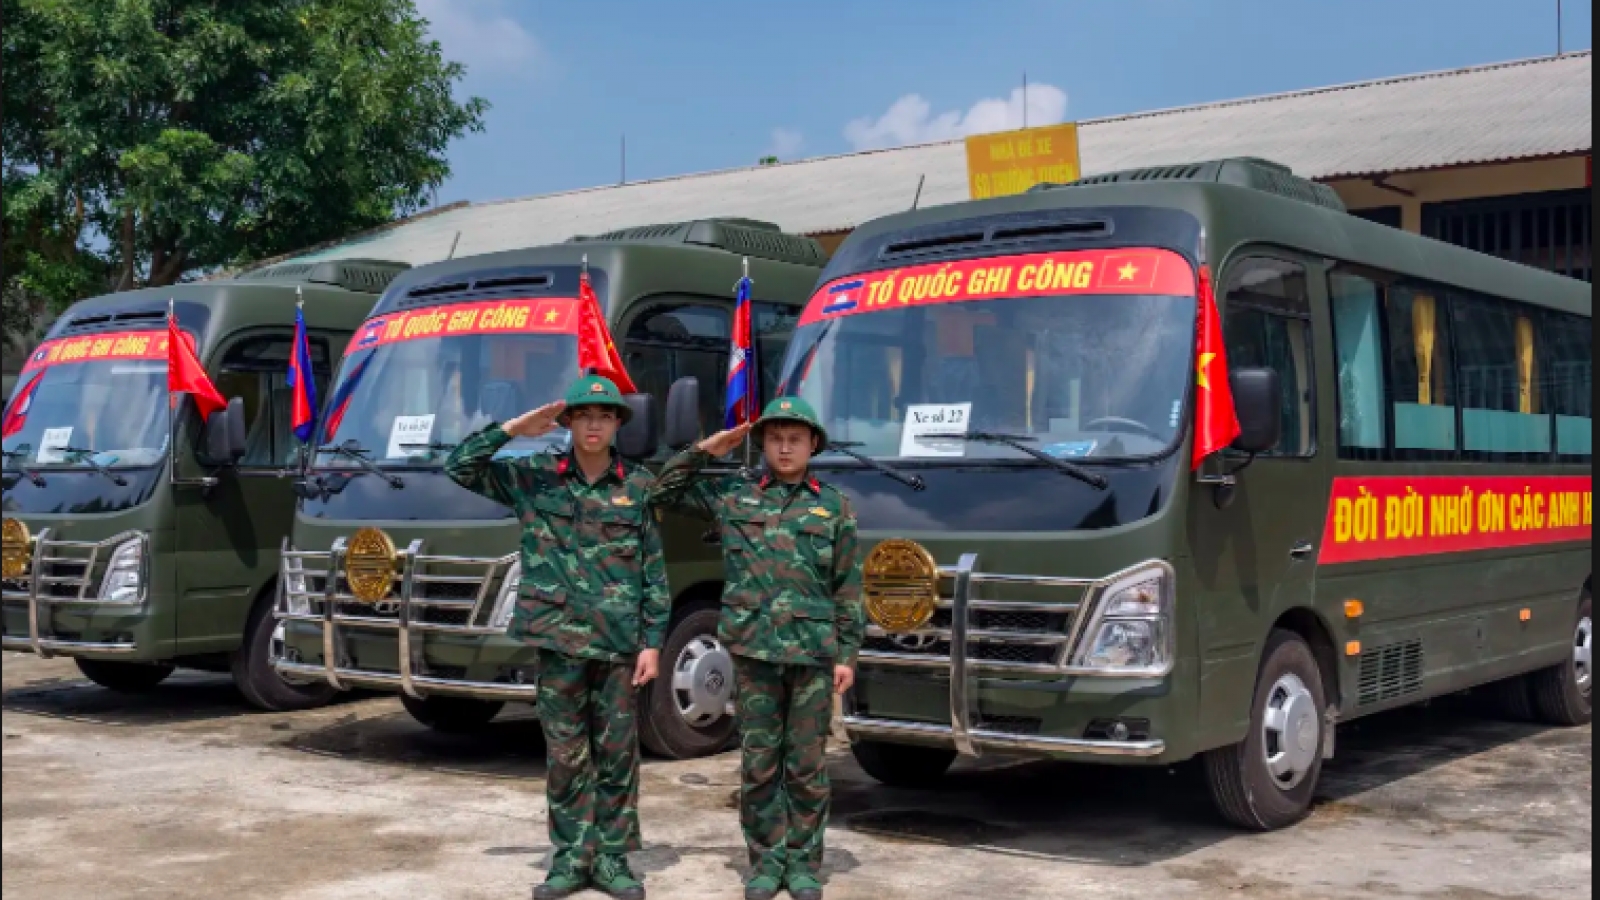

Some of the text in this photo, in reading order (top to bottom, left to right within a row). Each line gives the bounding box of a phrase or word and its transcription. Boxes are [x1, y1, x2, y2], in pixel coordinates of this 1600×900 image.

[898, 262, 963, 304] QUỐC
[967, 267, 1012, 294] GHI
[1017, 261, 1093, 291] CÔNG
[447, 308, 479, 331] GHI
[479, 302, 531, 329] CÔNG
[913, 411, 929, 423] Xe
[931, 407, 944, 423] số
[1334, 486, 1378, 542] ĐỜI
[1385, 486, 1424, 539] ĐỜI
[1430, 485, 1473, 536] NHỚ
[1477, 489, 1504, 532] ƠN
[1509, 486, 1544, 531] CÁC
[1547, 491, 1580, 528] ANH
